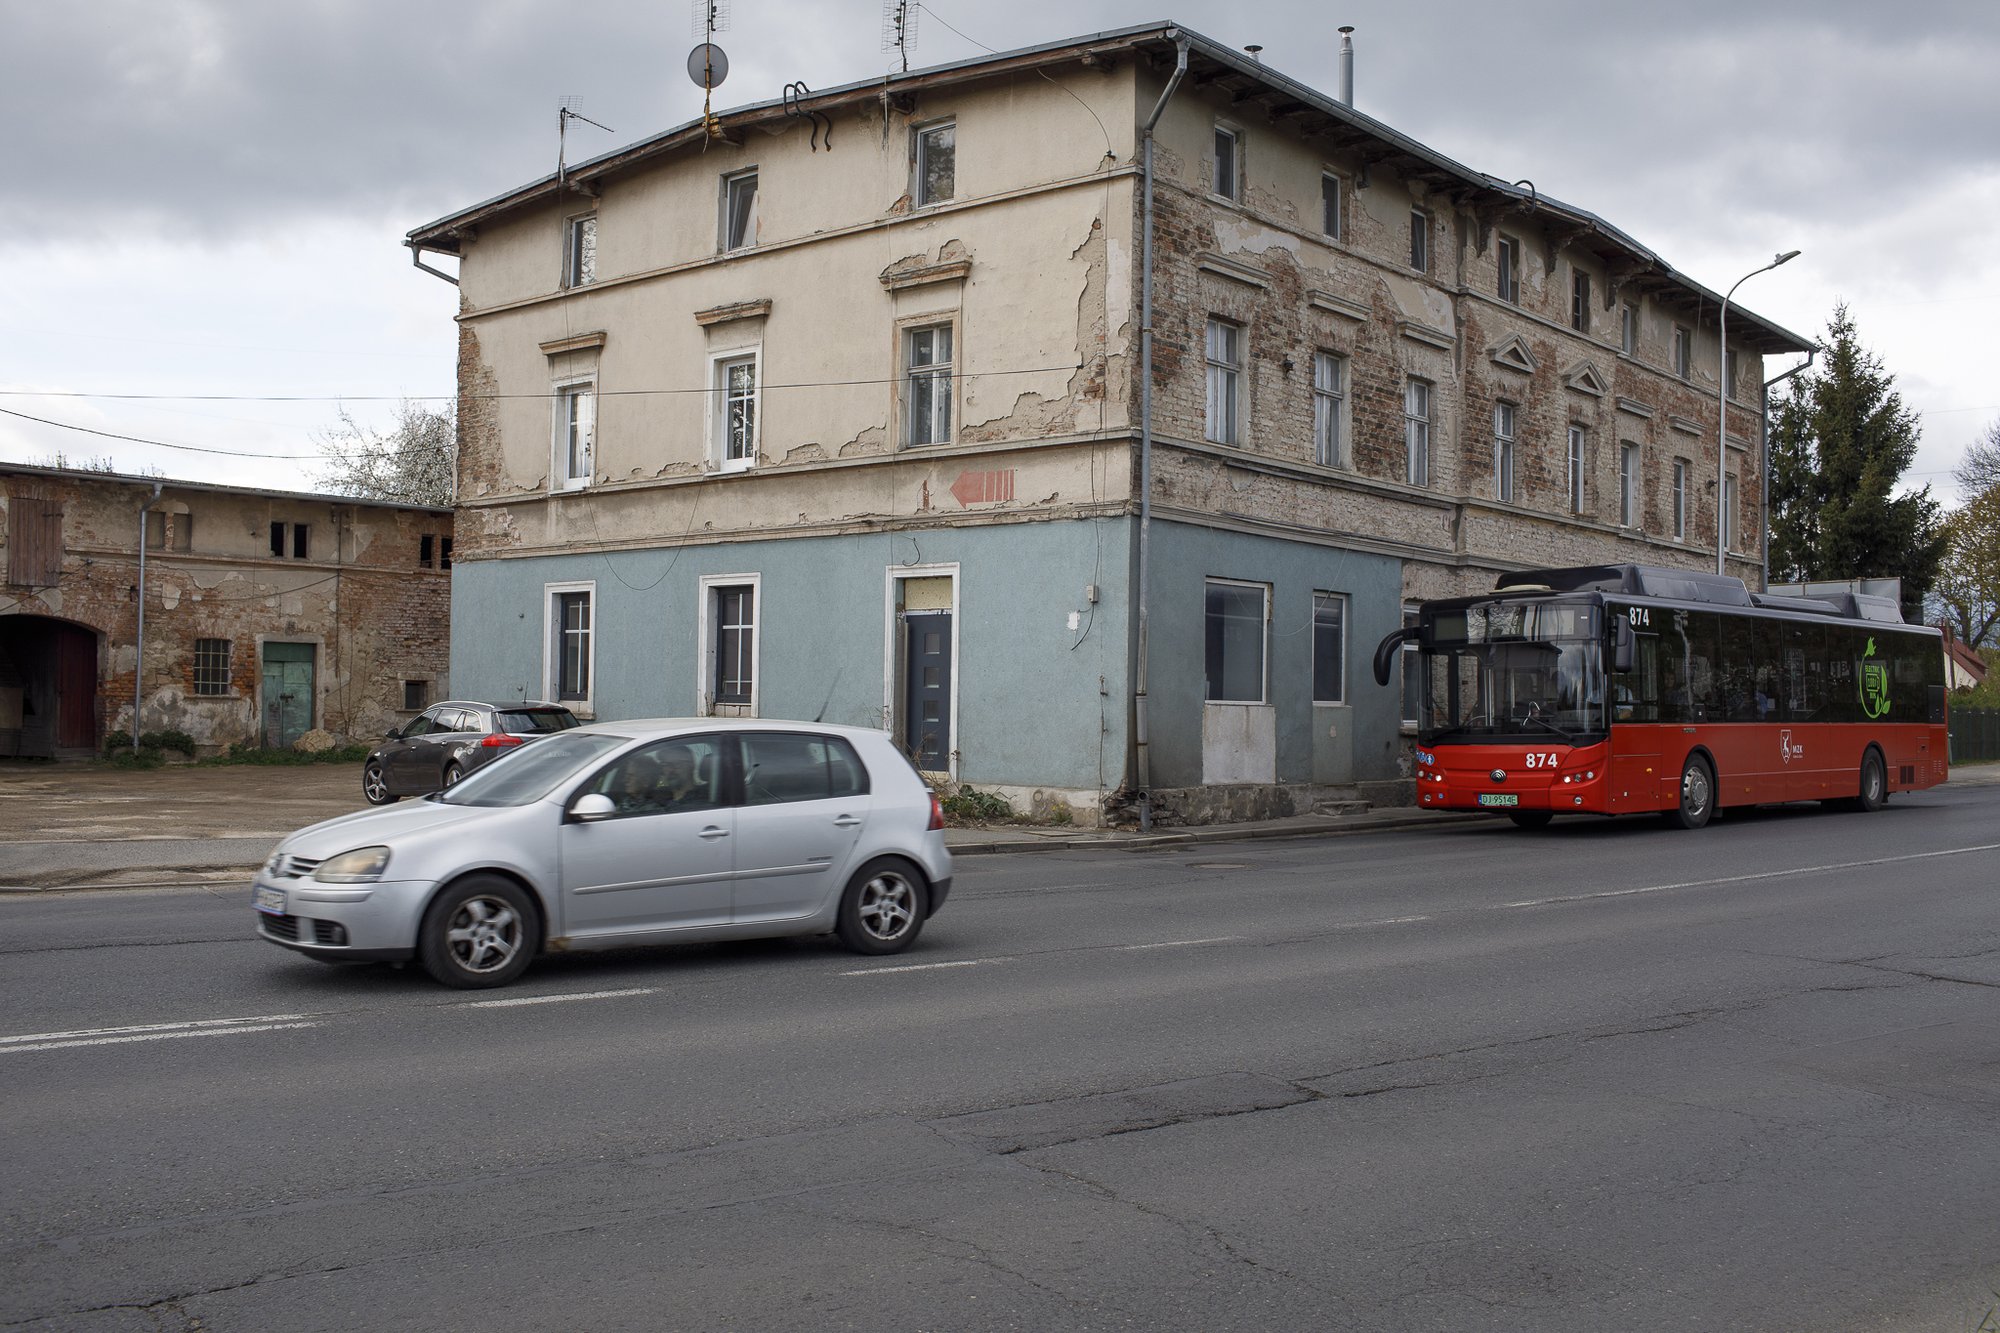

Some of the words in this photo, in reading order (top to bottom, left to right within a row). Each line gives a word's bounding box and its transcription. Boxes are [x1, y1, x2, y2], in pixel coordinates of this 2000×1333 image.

[1630, 607, 1649, 626] 874
[1792, 745, 1803, 754] MZK
[1526, 753, 1557, 768] 874
[1482, 795, 1492, 804] DJ
[1493, 795, 1516, 804] 9514E
